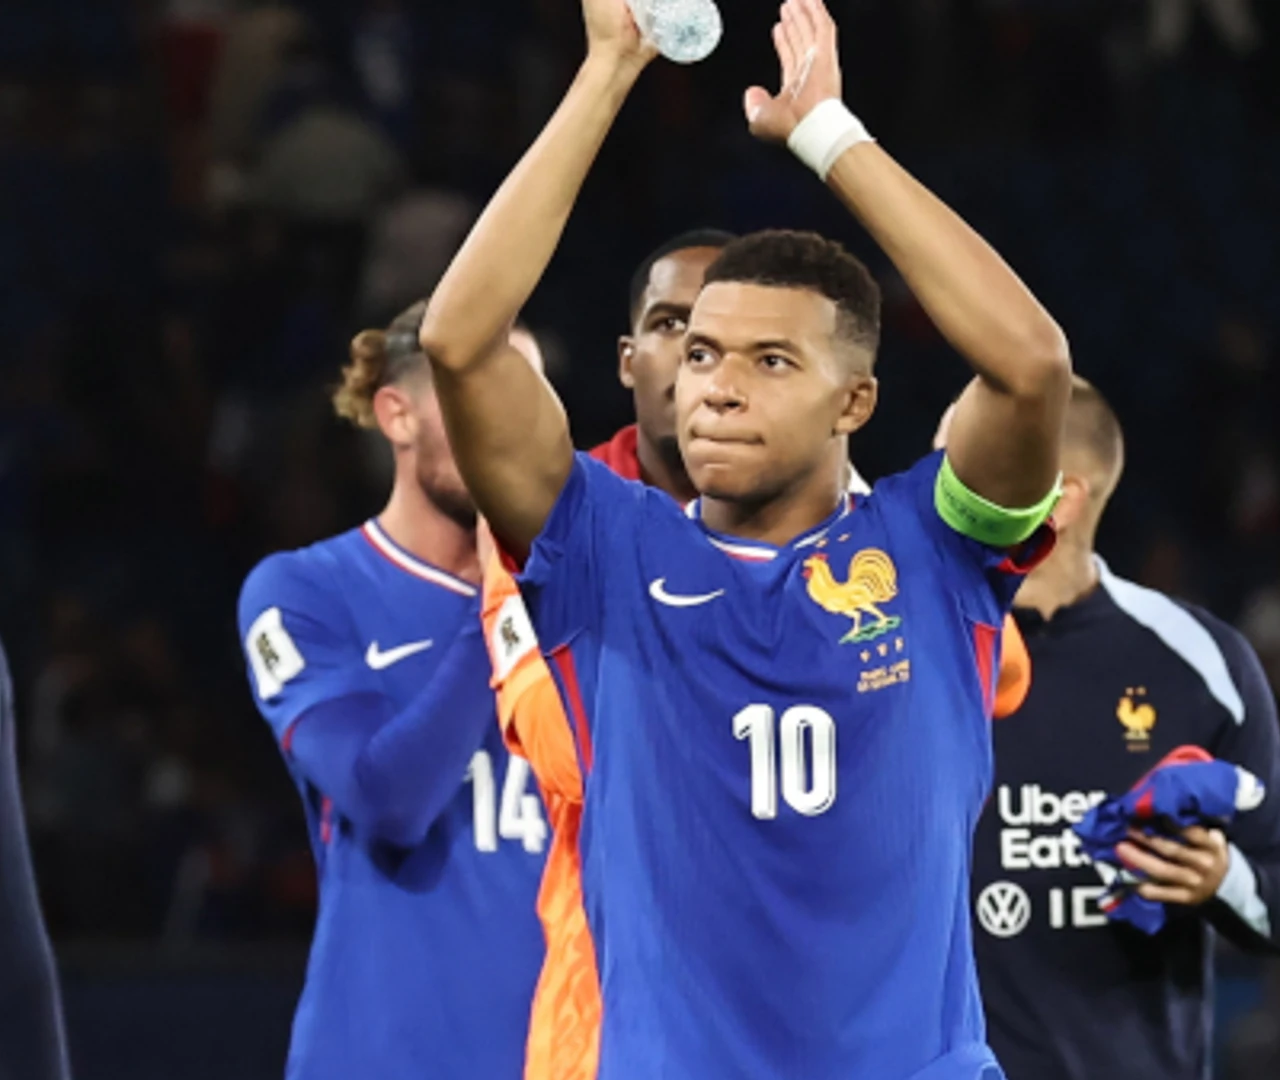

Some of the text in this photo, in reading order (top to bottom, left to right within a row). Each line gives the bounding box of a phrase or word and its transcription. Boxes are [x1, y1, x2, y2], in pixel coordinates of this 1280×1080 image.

[463, 749, 547, 854] 14
[732, 703, 837, 820] 10
[1000, 828, 1092, 869] Eat
